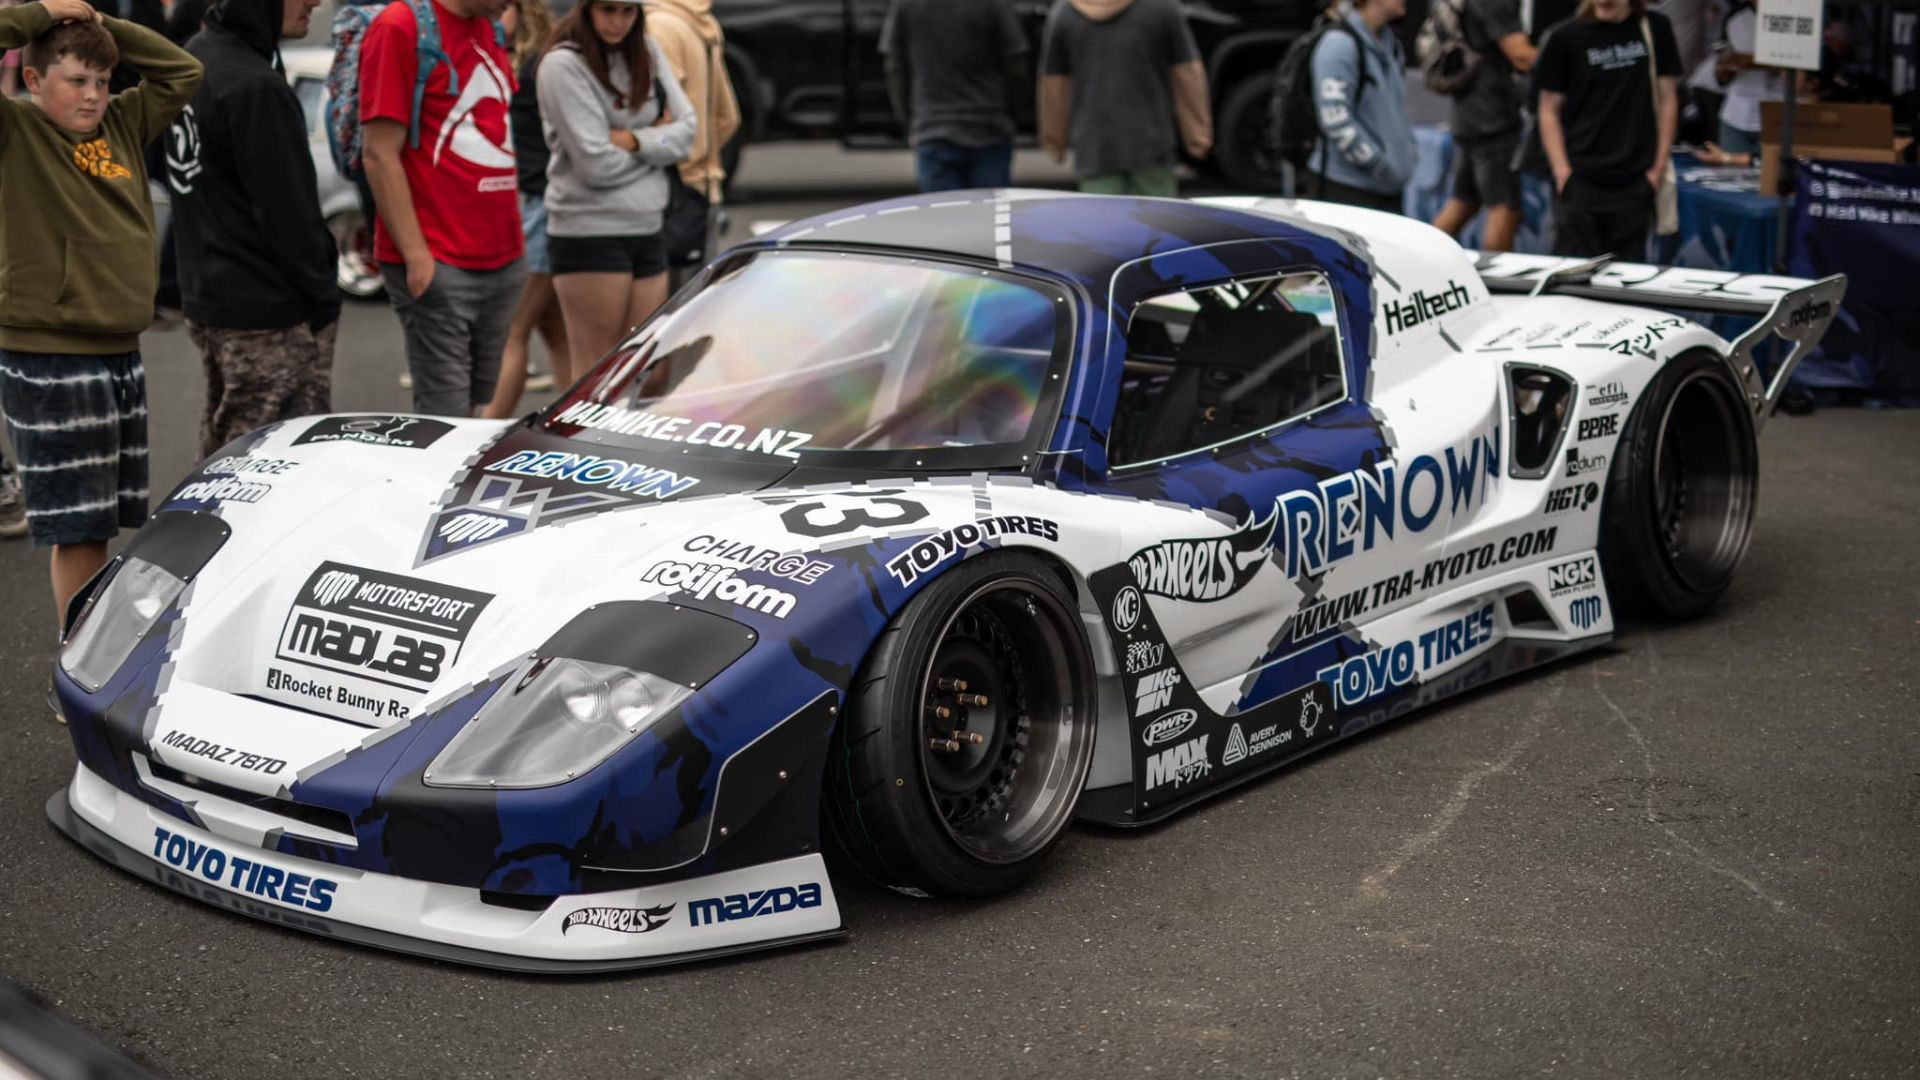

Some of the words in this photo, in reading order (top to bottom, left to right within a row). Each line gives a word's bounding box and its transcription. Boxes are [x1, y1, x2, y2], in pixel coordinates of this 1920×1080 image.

[1382, 279, 1470, 336] Haltech
[310, 432, 414, 447] PANDEM
[553, 400, 813, 459] MADMIKE.CO.NZ
[203, 456, 300, 475] CHARGE
[484, 450, 700, 499] RENOWN
[173, 476, 271, 504] rotiform
[1277, 426, 1500, 579] RENOWN
[1544, 484, 1585, 514] HGT
[683, 534, 835, 585] CHARGE
[886, 522, 981, 589] TOYO
[974, 514, 1059, 543] TIRES
[640, 560, 797, 619] rotiform
[1292, 526, 1557, 643] WWW.TRA-KYOTO.COM
[1549, 558, 1594, 590] NGK
[354, 581, 475, 621] MOTORSPORT
[1116, 590, 1137, 628] KC
[1317, 639, 1416, 711] TOYO
[1419, 602, 1494, 670] TIRES
[282, 673, 332, 700] Rocket
[337, 687, 385, 717] Bunny
[1148, 712, 1192, 747] PWR
[1249, 730, 1292, 756] DENNISON
[1250, 724, 1277, 745] AVERY
[162, 730, 232, 763] MADAZ
[229, 751, 287, 775] 787D
[1145, 734, 1209, 791] MAX
[1175, 757, 1213, 789] ドリフト
[154, 827, 227, 881] TOYO
[230, 857, 338, 913] TIRES
[568, 910, 588, 924] HOT
